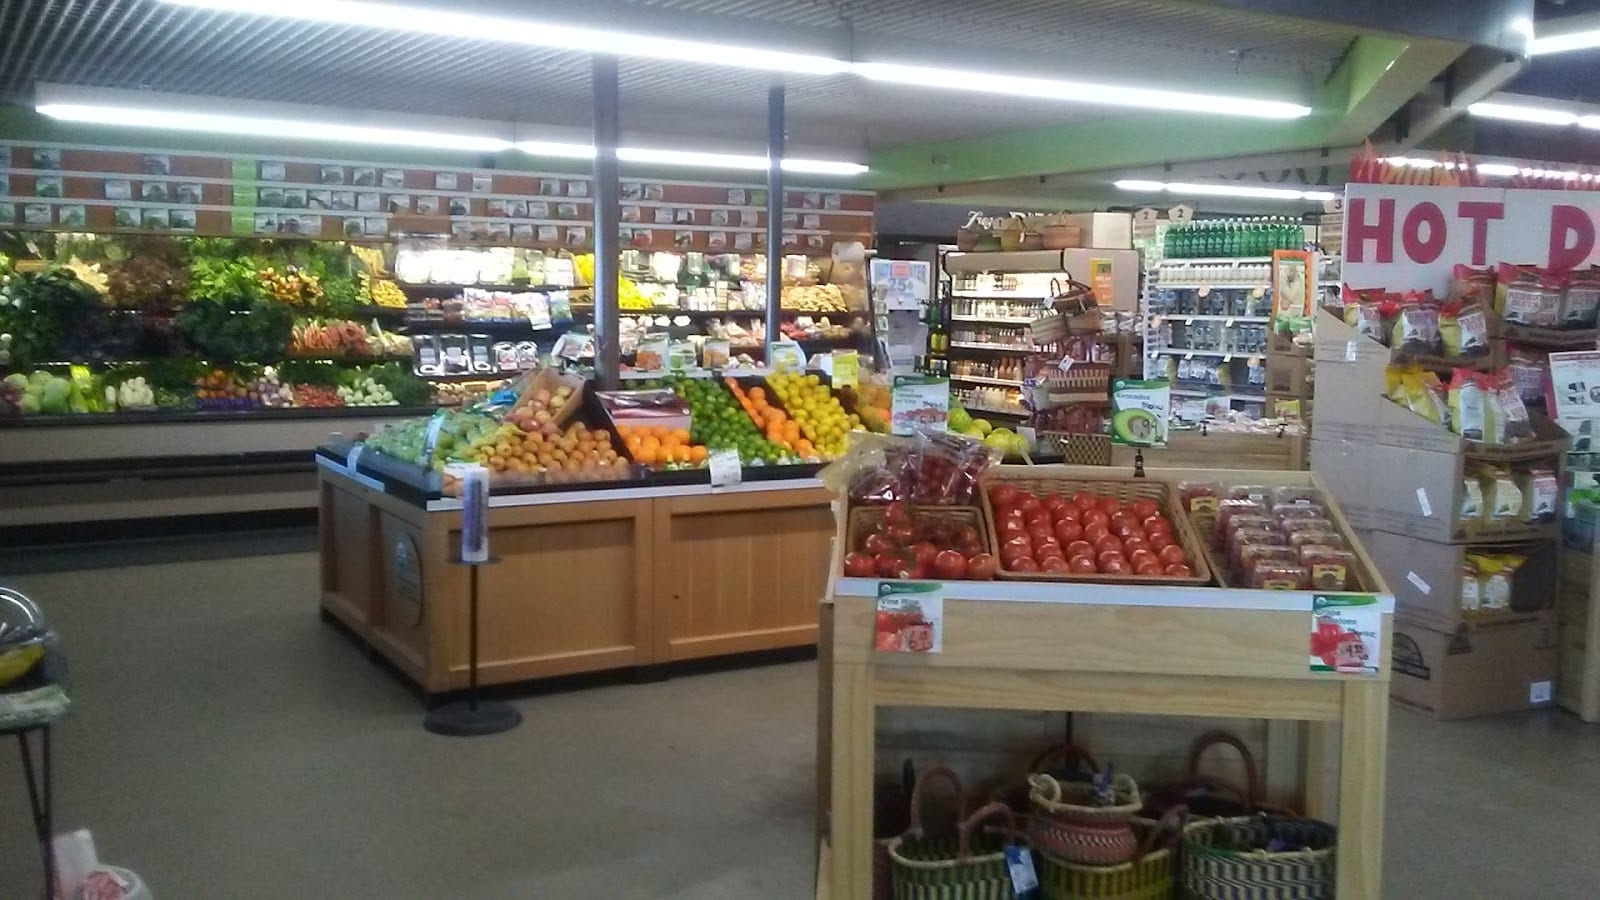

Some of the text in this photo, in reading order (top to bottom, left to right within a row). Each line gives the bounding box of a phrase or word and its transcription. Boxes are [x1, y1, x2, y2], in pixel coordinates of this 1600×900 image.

[1334, 198, 1342, 209] 3
[1143, 211, 1149, 220] 2
[1177, 208, 1184, 218] 2
[1346, 198, 1504, 266] HOT
[1116, 391, 1151, 400] Avocados
